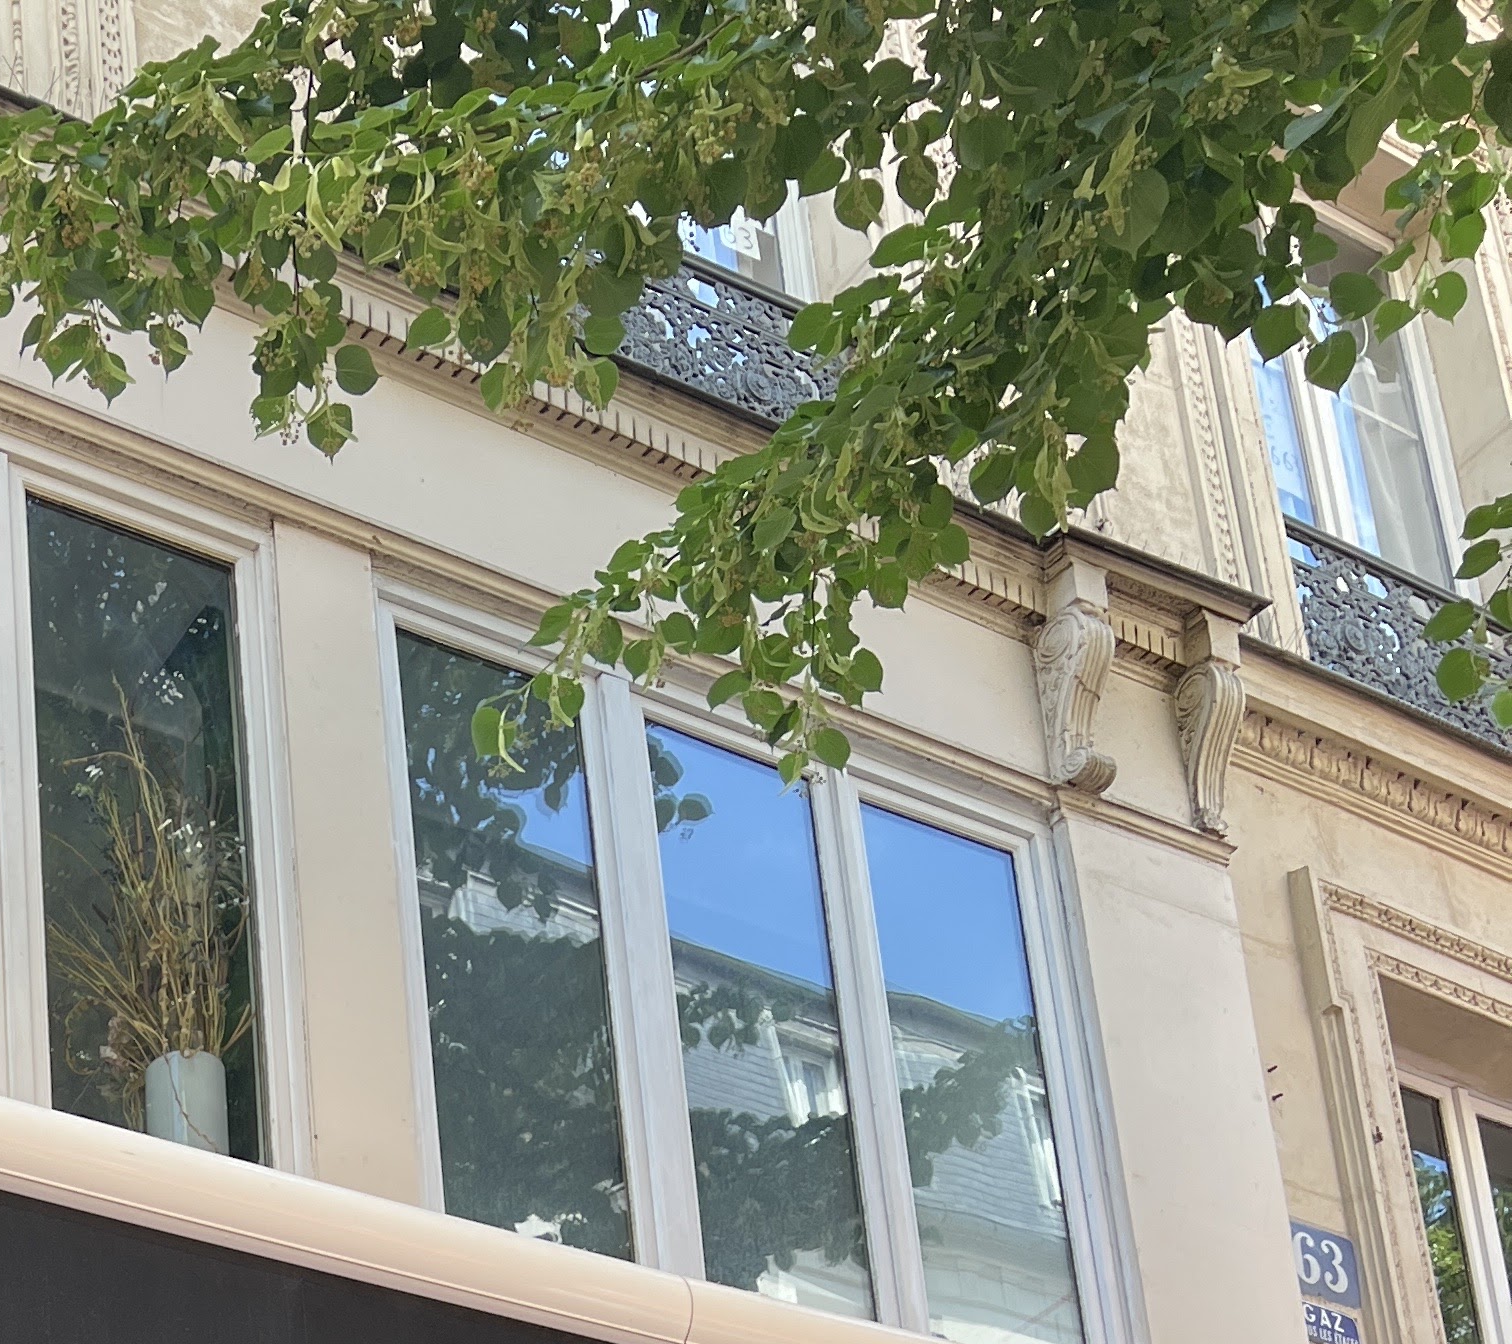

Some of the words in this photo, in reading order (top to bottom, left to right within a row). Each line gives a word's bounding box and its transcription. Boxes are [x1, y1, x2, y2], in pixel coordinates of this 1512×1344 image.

[1293, 1231, 1349, 1293] 63
[1304, 1303, 1345, 1333] GAZ
[1319, 1328, 1333, 1343] LES
